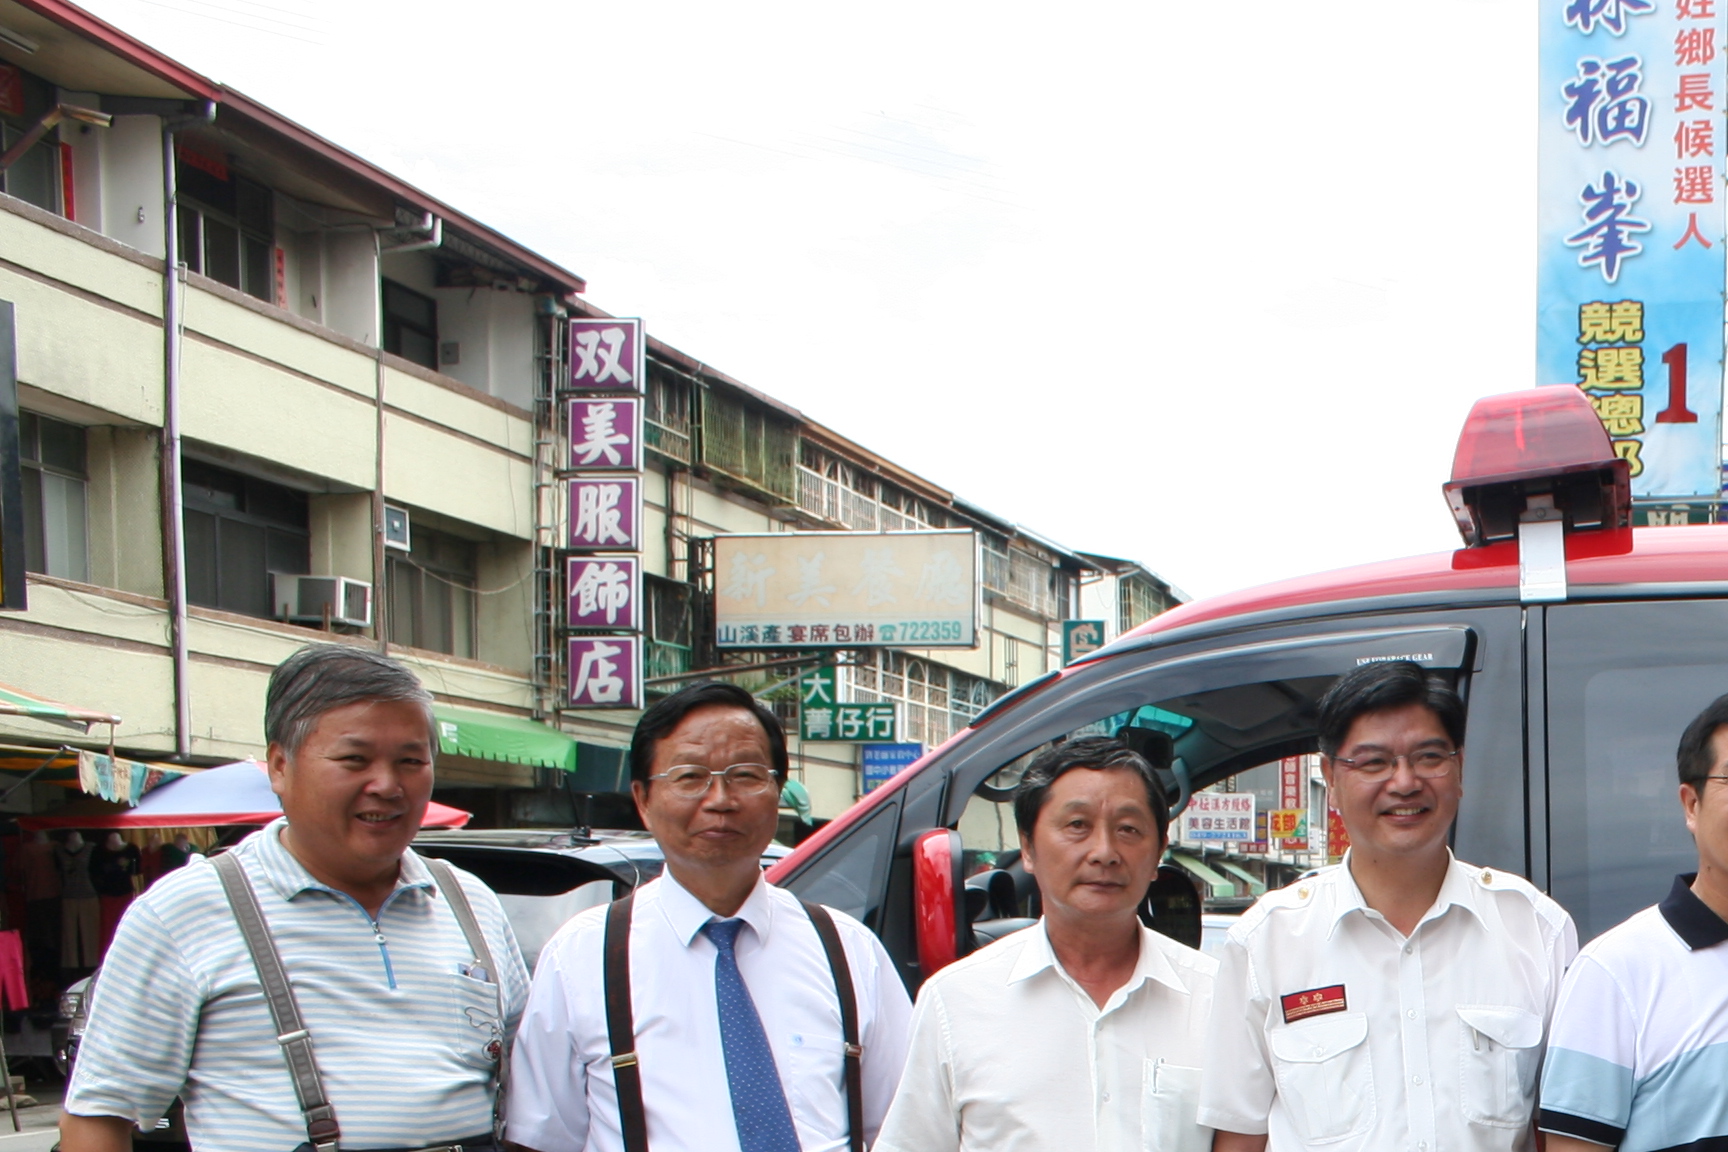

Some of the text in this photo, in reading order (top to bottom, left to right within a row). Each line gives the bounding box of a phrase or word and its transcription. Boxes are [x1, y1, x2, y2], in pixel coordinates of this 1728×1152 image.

[1656, 343, 1698, 423] 1
[570, 326, 632, 703] 双美服飾店
[899, 621, 962, 642] 722359
[803, 673, 831, 703] 大
[804, 707, 895, 739] 菁仔行
